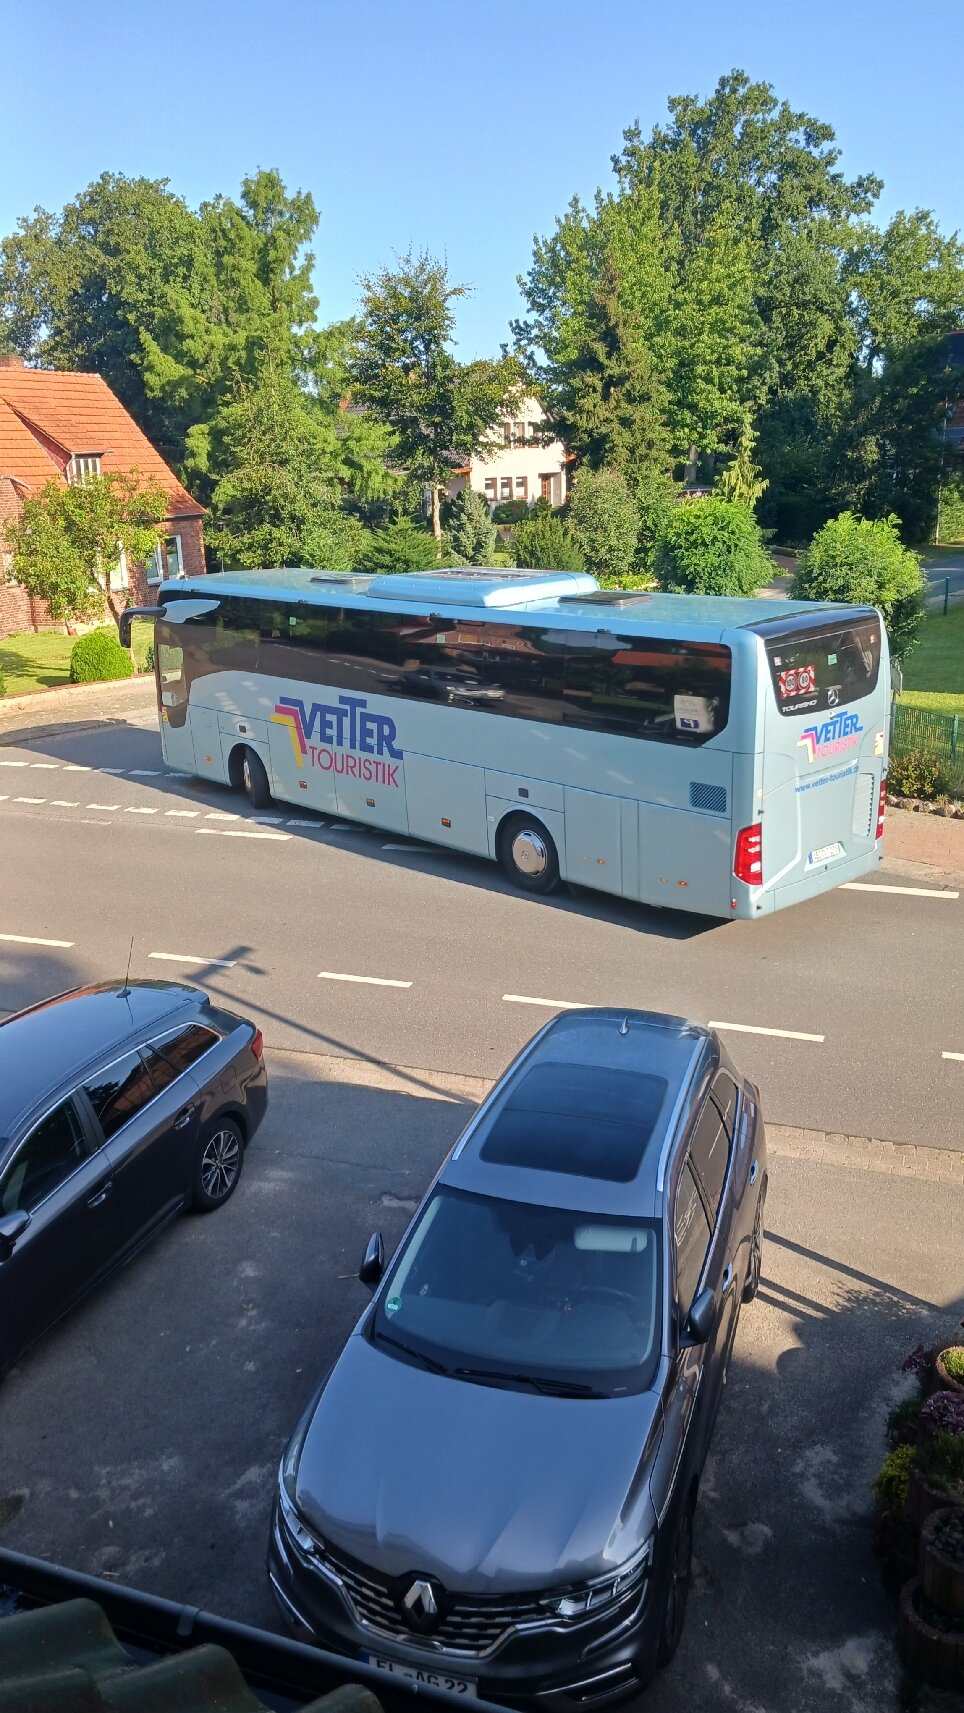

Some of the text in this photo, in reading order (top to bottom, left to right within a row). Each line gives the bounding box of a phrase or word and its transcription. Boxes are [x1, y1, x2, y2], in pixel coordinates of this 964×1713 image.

[782, 699, 817, 712] TOURISMO
[279, 695, 403, 760] VETTER
[804, 711, 863, 744] VETTER
[817, 735, 858, 757] TOURISTIK
[309, 746, 399, 788] TOURISTIK
